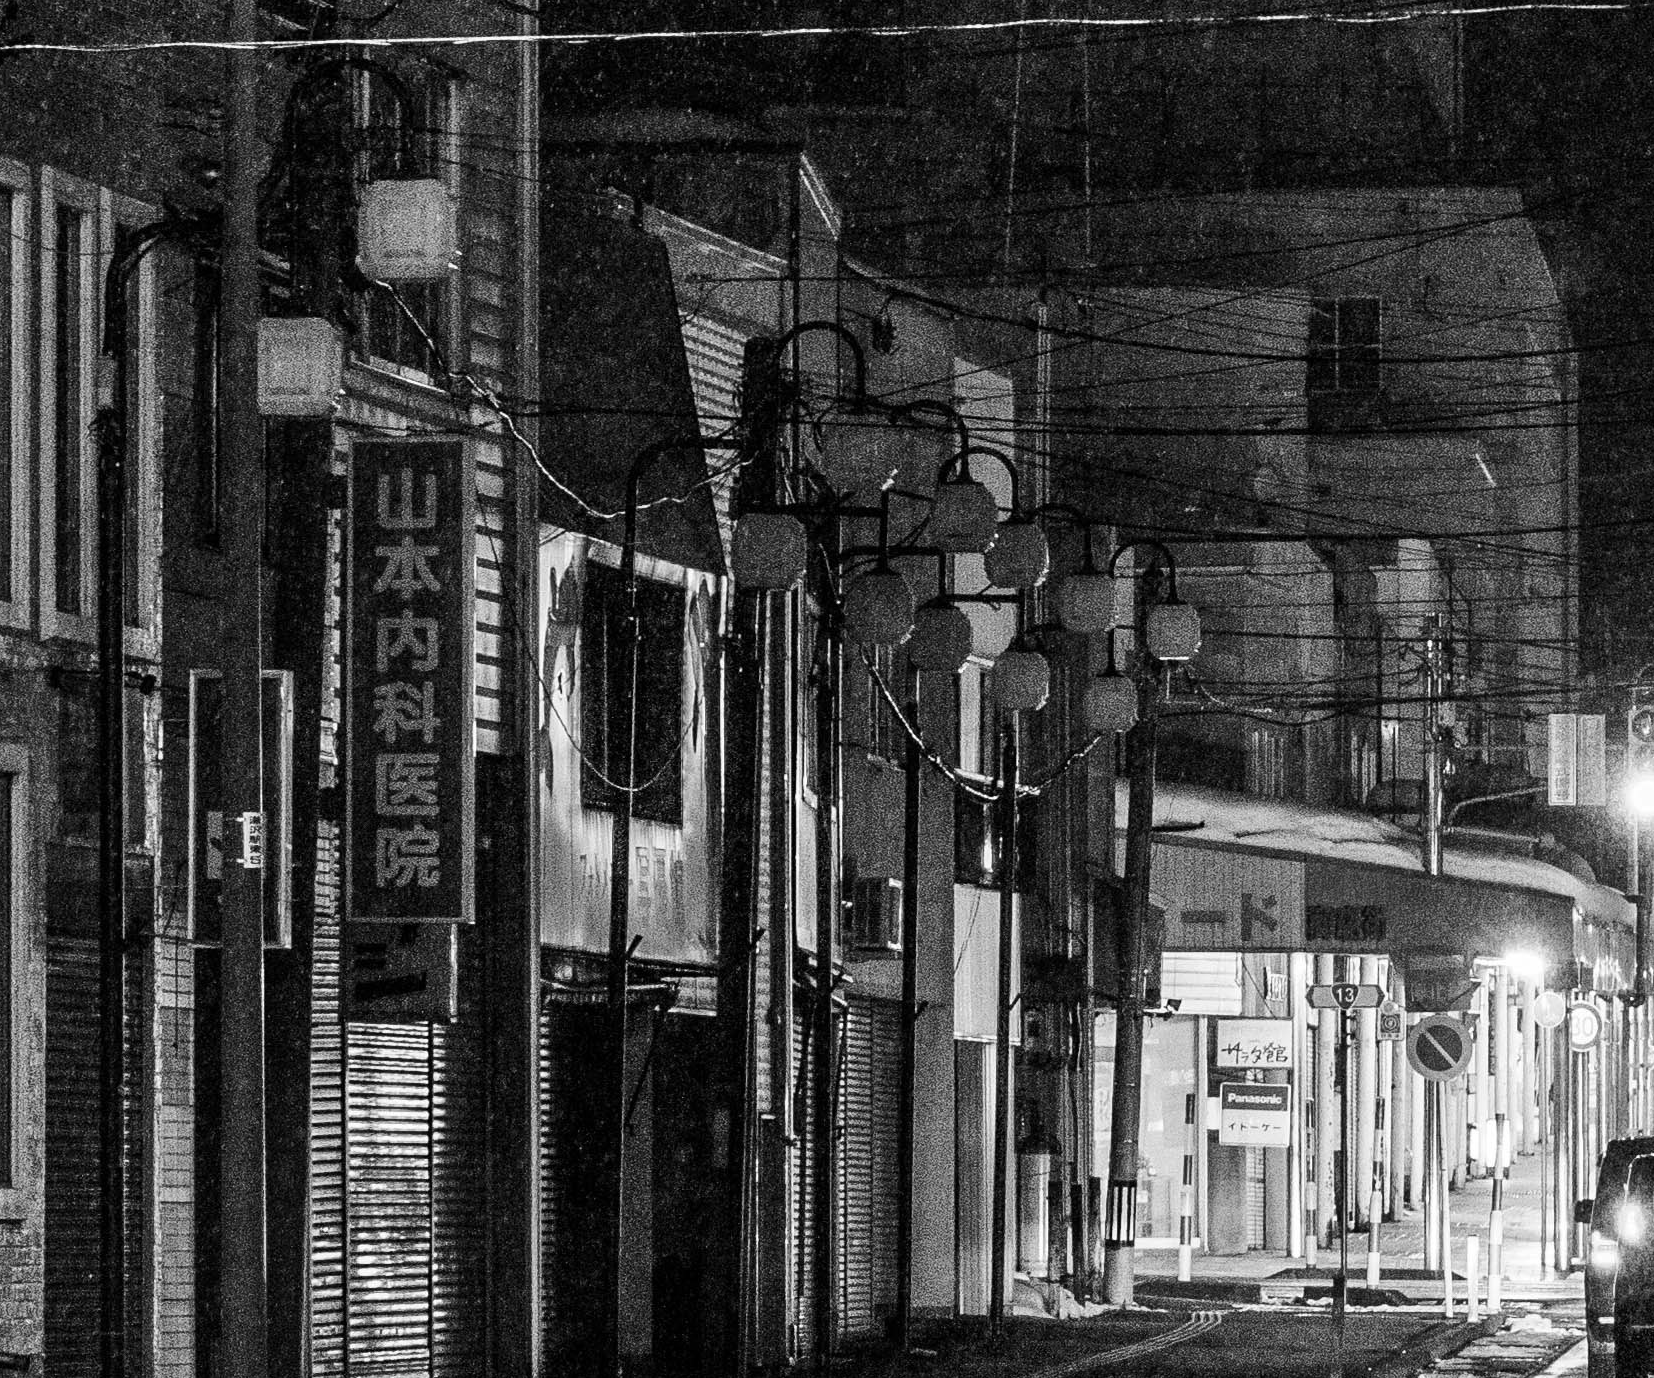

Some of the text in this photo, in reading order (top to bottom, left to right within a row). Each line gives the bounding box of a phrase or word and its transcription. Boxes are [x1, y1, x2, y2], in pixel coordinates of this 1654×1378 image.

[372, 467, 442, 890] 山本内科医院
[1335, 987, 1355, 1004] 13
[1227, 1092, 1283, 1106] Panasonic
[1228, 1122, 1283, 1132] イトーケー
